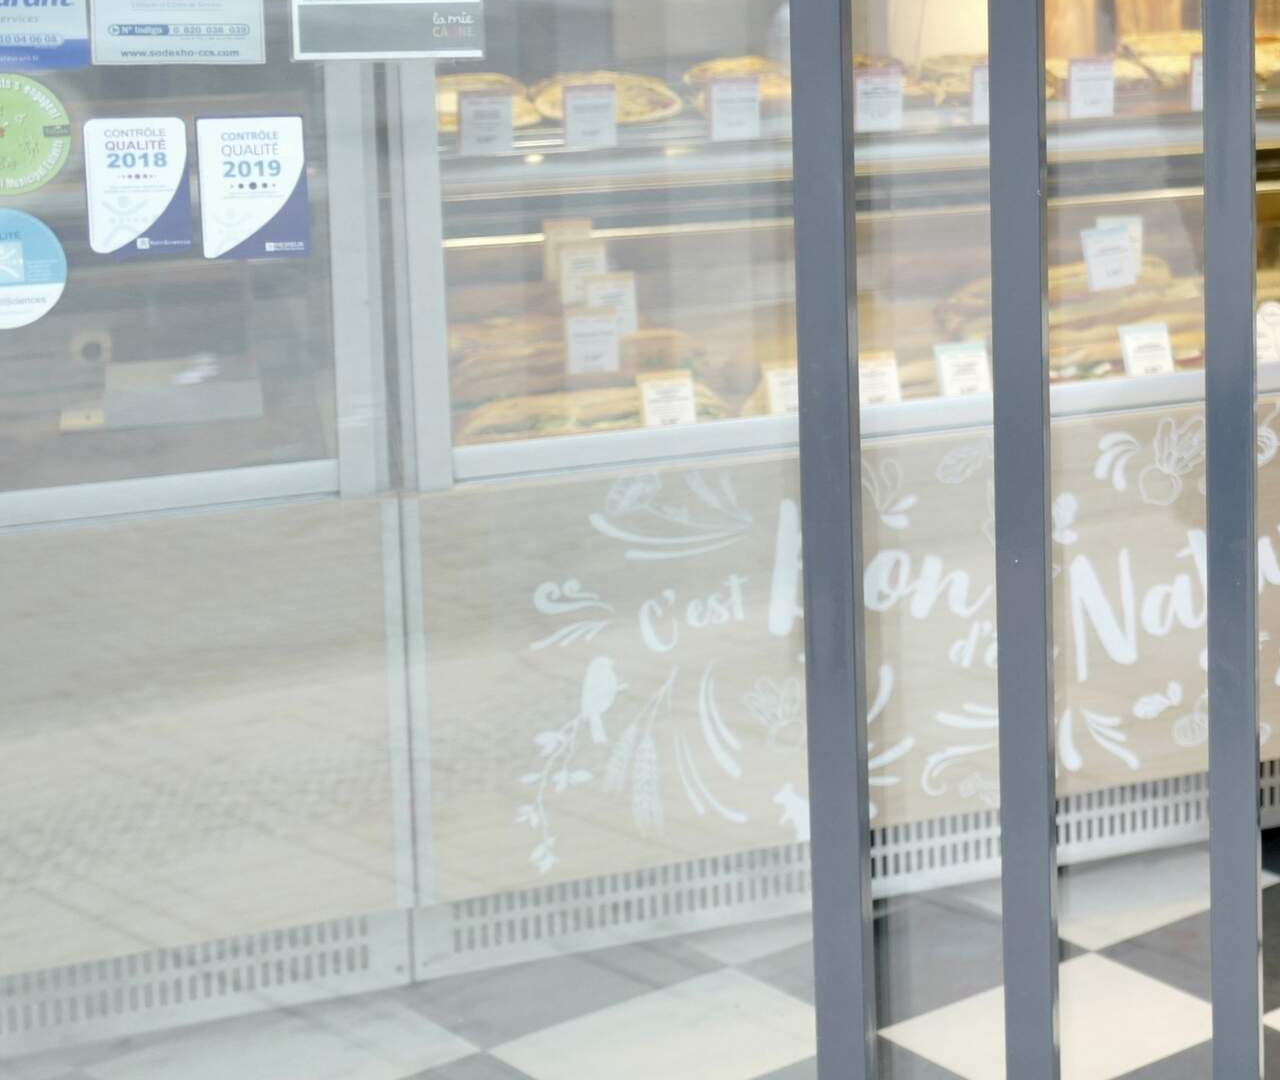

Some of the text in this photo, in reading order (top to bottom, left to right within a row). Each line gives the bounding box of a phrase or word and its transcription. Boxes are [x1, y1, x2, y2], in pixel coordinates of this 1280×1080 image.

[104, 127, 166, 138] CONTRÔLE
[221, 130, 279, 142] CONTRÔLE
[105, 139, 167, 152] QUALITÉ
[221, 142, 279, 157] QUALITÉ
[106, 152, 168, 168] 2018
[222, 160, 281, 178] 2019
